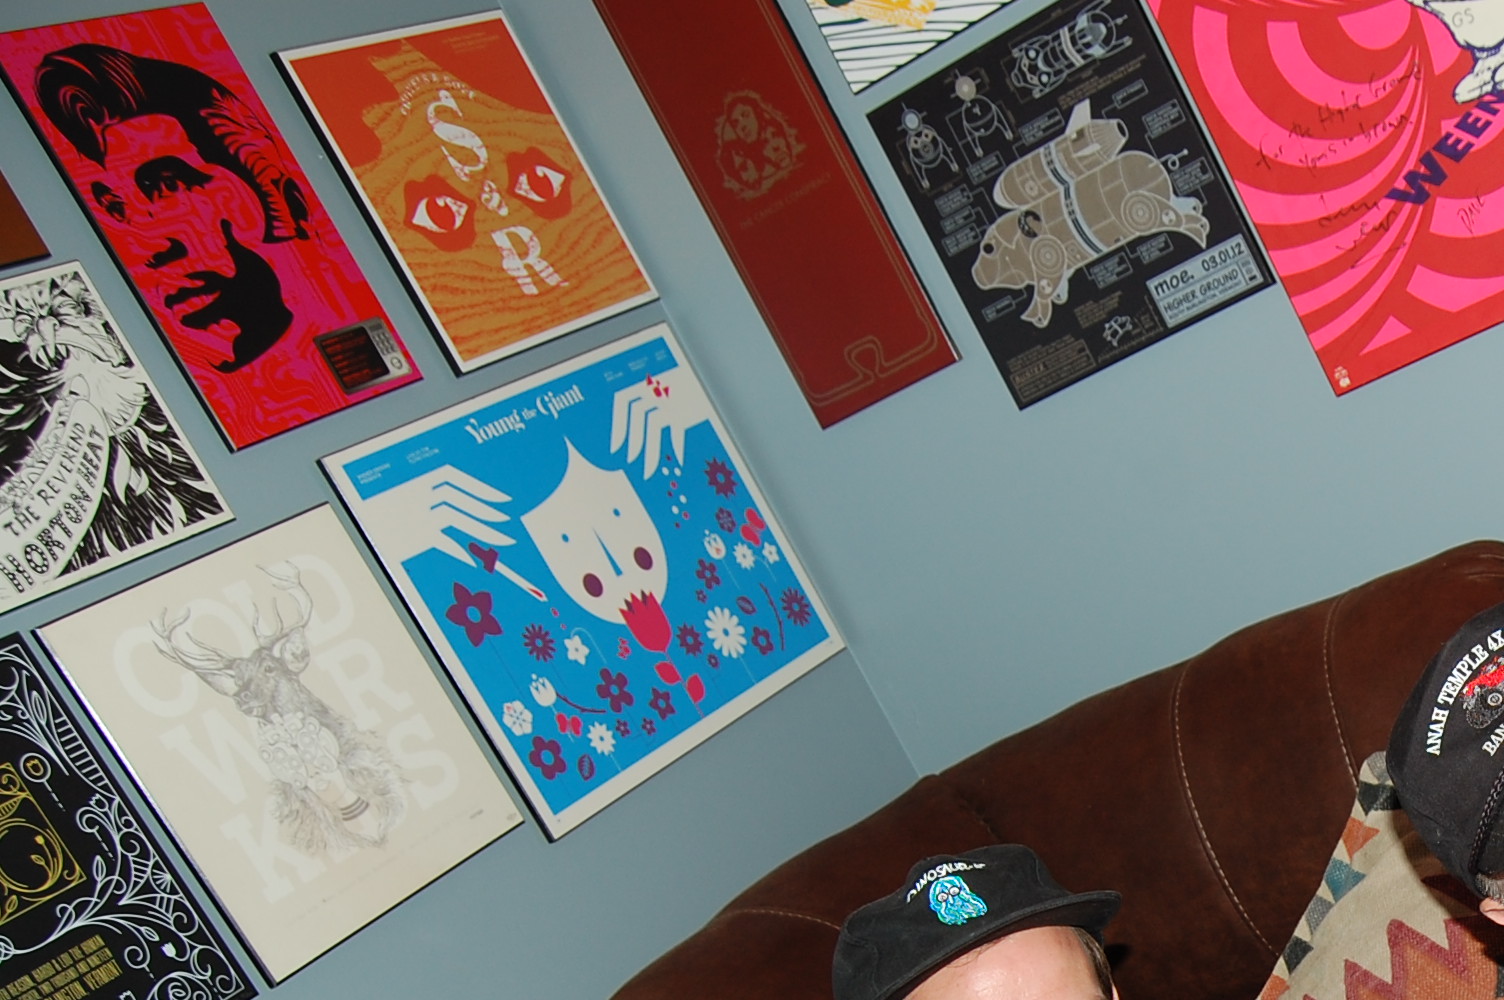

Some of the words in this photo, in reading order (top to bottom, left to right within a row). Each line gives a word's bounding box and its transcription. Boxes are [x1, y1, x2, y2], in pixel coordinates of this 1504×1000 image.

[1154, 269, 1195, 297] moe.
[1163, 289, 1198, 314] HIGHER
[1199, 268, 1239, 296] GROUND
[464, 409, 525, 444] Young
[521, 407, 538, 421] the
[536, 384, 586, 419] Giant
[0, 482, 93, 593] HORTON
[77, 424, 105, 489] HEAT
[3, 505, 41, 537] THE
[37, 422, 86, 506] REVEREND
[113, 554, 355, 718] COLD
[1426, 707, 1449, 757] ANAH
[1438, 644, 1489, 706] TEMPLE
[82, 958, 123, 992] VERMONT
